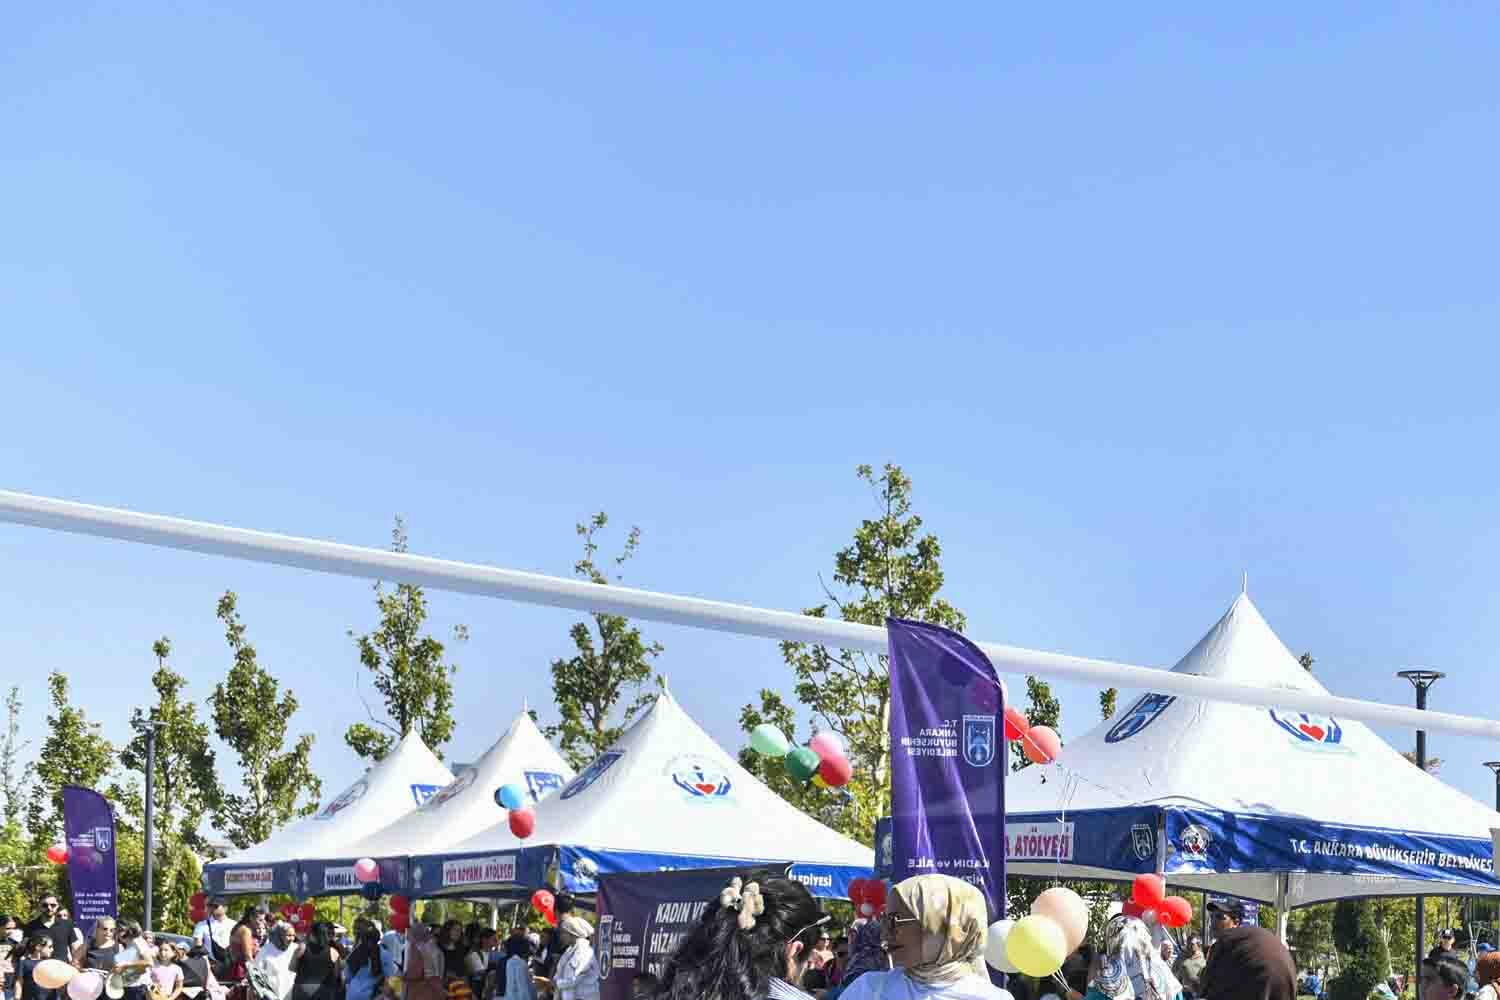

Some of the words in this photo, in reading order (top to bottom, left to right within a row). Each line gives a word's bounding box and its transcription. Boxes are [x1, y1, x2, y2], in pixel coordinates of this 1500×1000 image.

[1290, 839, 1311, 855] T.C.
[1314, 841, 1363, 858] ANKARA
[1438, 854, 1495, 872] BELEDİYES
[656, 902, 691, 923] KADIN
